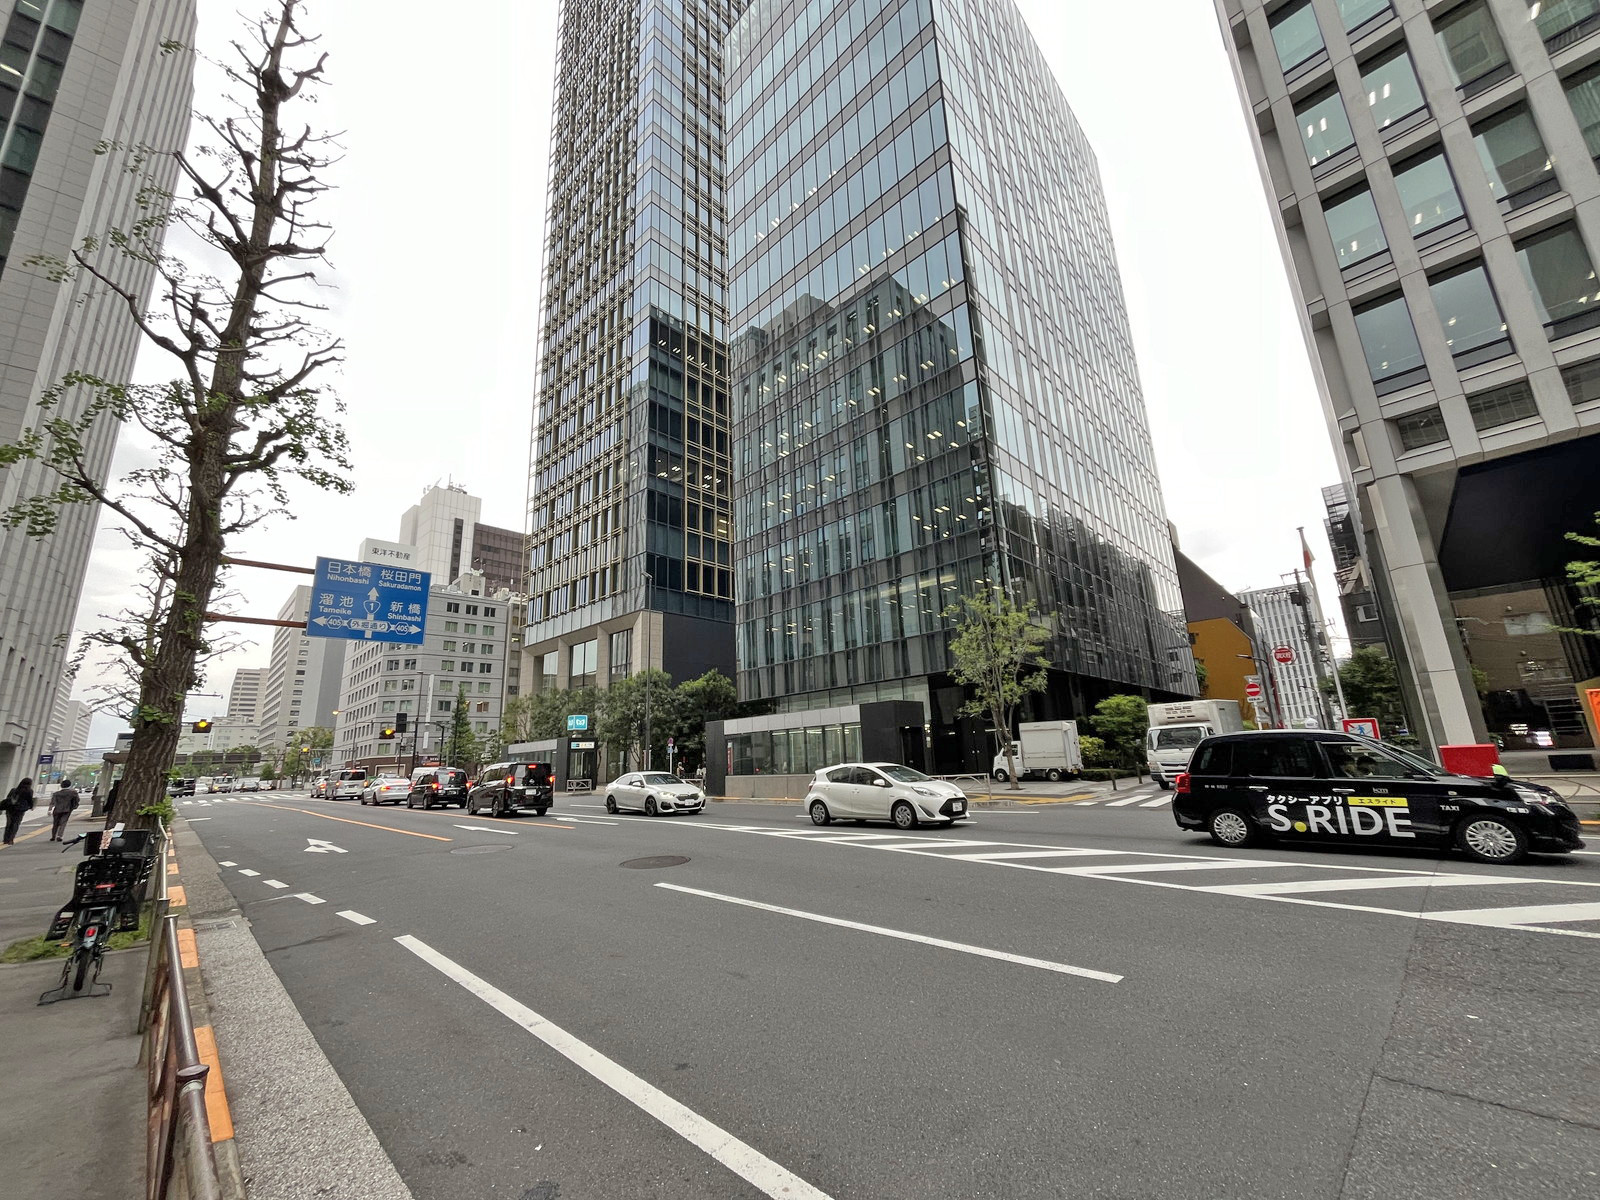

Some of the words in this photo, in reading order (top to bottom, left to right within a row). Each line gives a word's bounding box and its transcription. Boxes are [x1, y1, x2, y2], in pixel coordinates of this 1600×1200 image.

[372, 548, 410, 560] 東洋不動産
[328, 562, 372, 578] 日本橋
[327, 574, 369, 584] Nihonbashi
[380, 568, 422, 584] 桜田門
[378, 580, 421, 591] Sakuradamon
[319, 593, 354, 608] 溜池
[319, 606, 352, 615] Tameike
[390, 601, 421, 615] 新橋
[328, 617, 341, 625] 405
[388, 613, 421, 622] Shinbashi
[352, 620, 386, 630] 外堀通り
[1267, 795, 1342, 805] タクシーアプリ
[1268, 804, 1416, 838] S.RIDE
